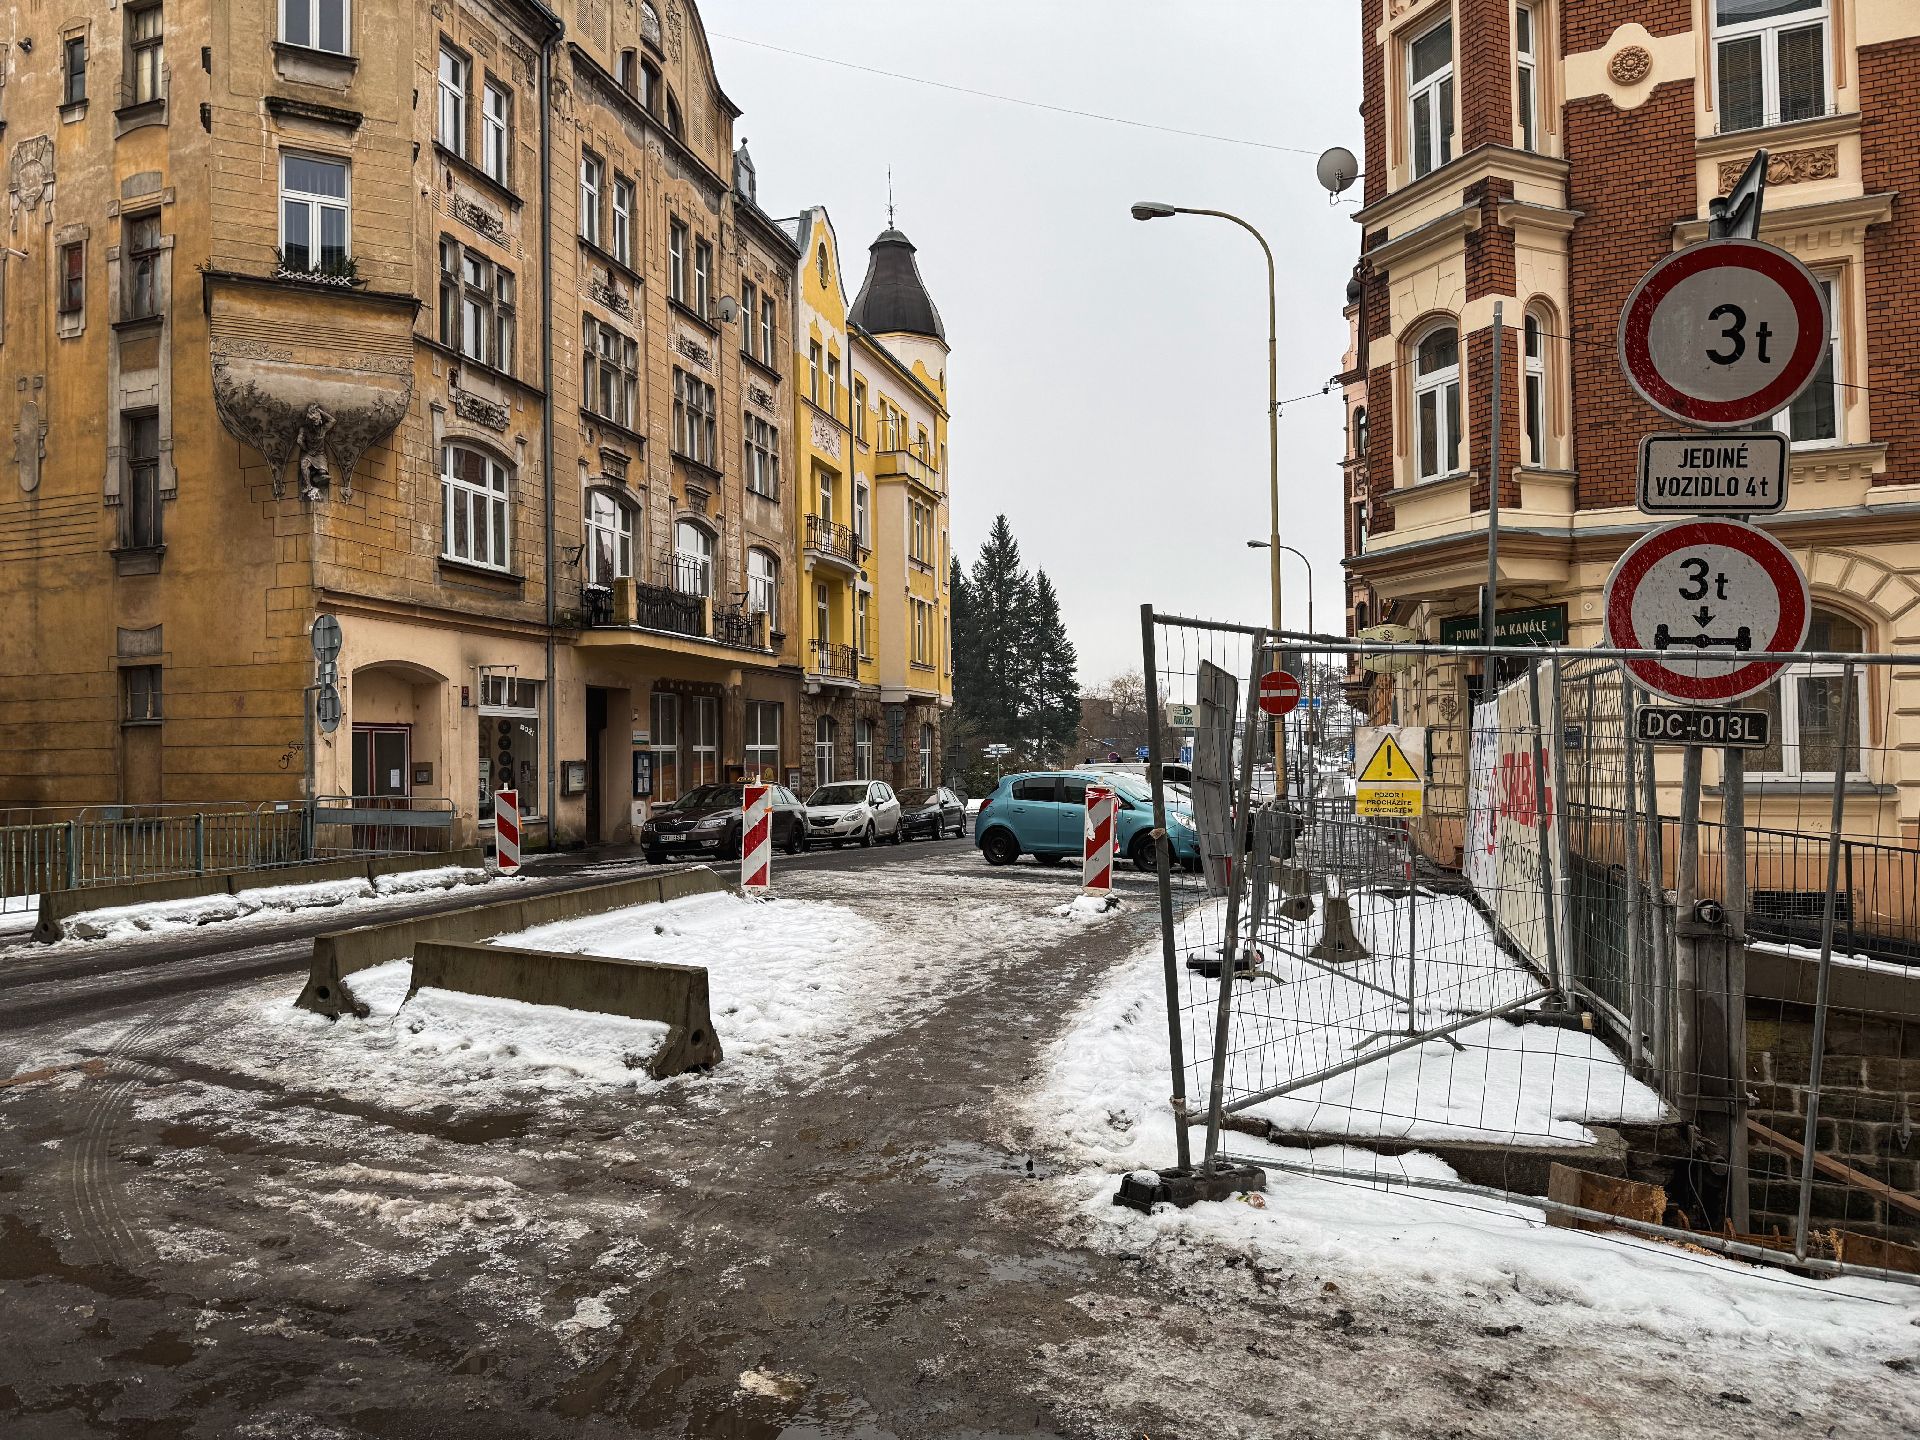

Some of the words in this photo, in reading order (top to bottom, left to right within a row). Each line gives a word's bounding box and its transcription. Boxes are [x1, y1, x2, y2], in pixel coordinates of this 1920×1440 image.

[1678, 442, 1748, 469] JEDINÉ
[1655, 476, 1739, 497] VOZIDLO
[1509, 619, 1548, 635] KANÁLE
[1646, 712, 1760, 740] DC-013L
